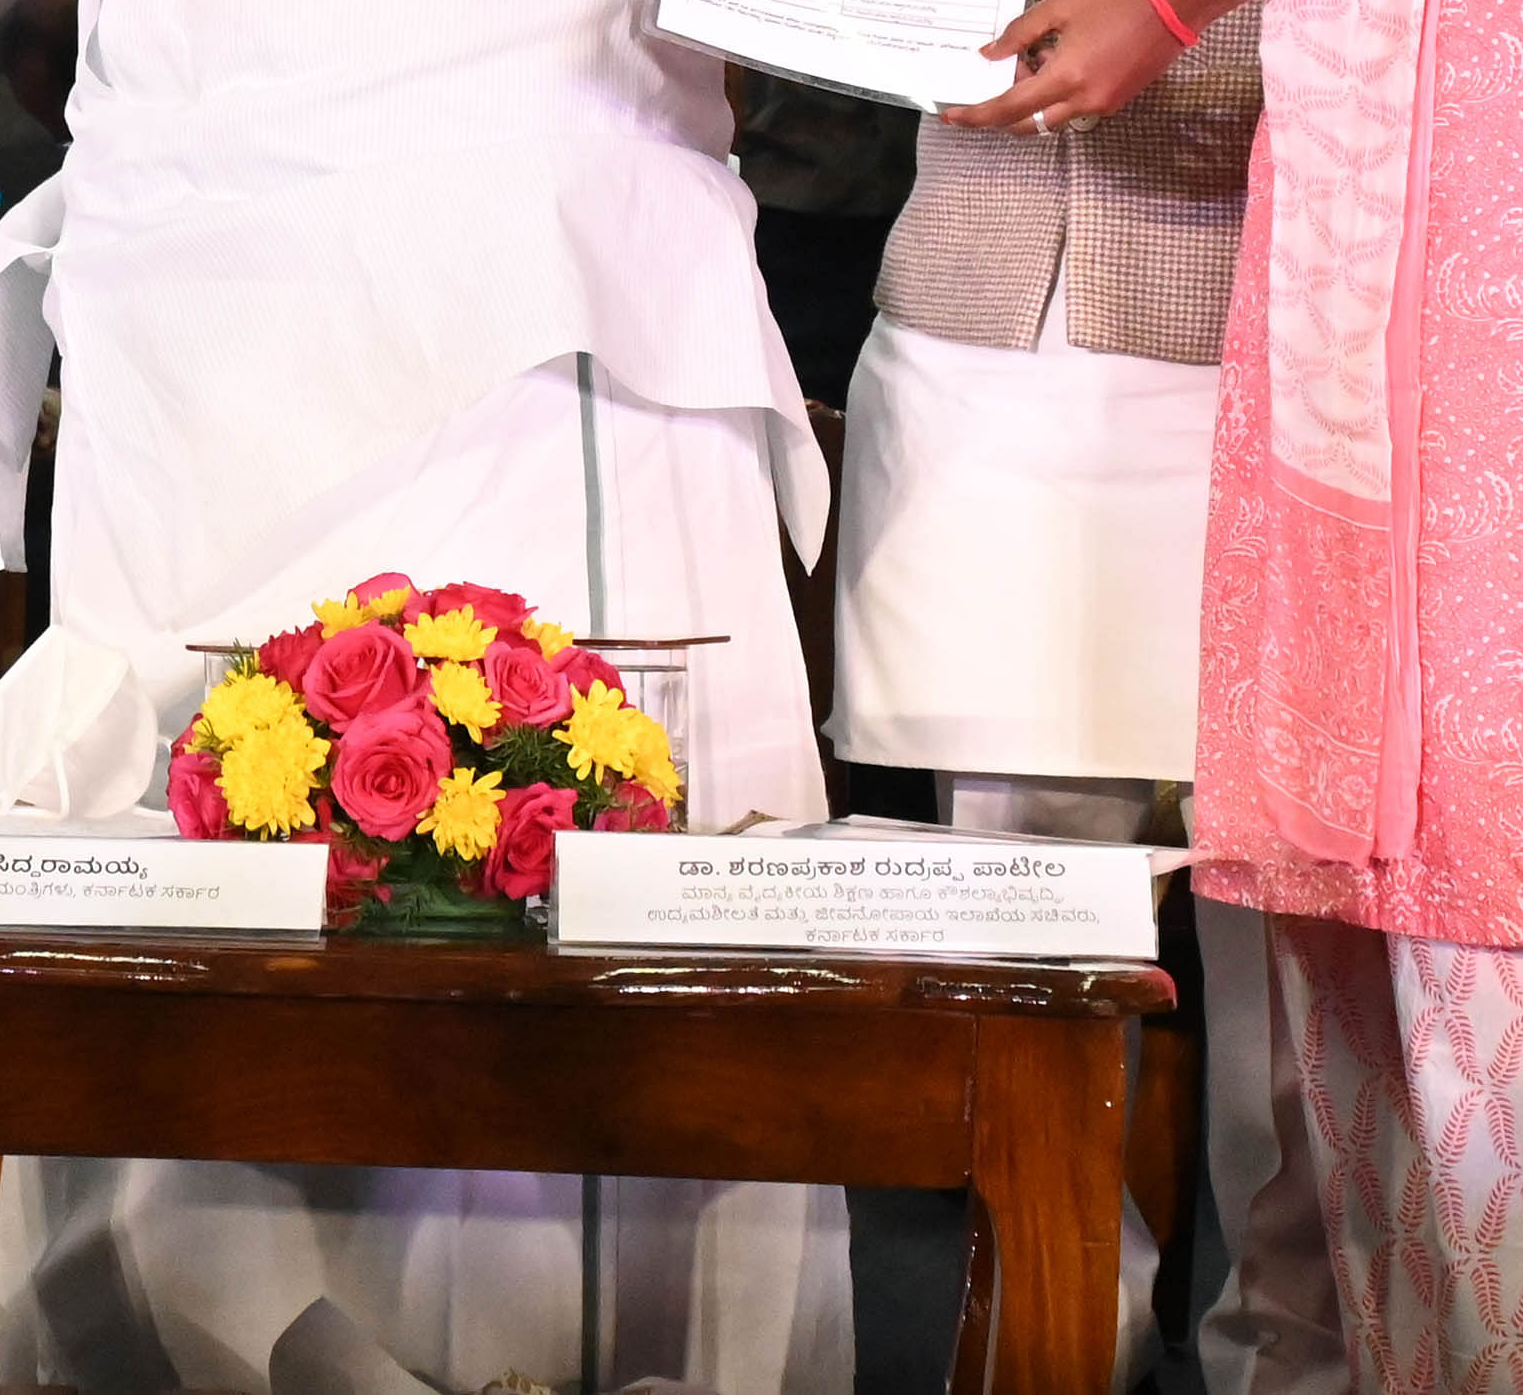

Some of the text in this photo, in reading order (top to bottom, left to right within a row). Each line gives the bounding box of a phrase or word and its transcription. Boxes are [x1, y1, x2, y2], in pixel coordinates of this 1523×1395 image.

[678, 855, 1066, 881] ಡಾ. ಶರಣಪ್ರಕಾಶ ರುದ್ರಪ್ಪ ಪಾಟೀಲ
[83, 883, 157, 899] ಕರ್ನಾಟಕ
[161, 885, 220, 900] ಸರ್ಕಾರ
[682, 885, 733, 902] ಮಾನ್ಯ
[738, 885, 828, 902] ವೈದ್ಯಕೀಯ
[833, 882, 874, 903] ಶಿಕ್ಷಣ
[879, 886, 932, 902] ಹಾಗೂ
[647, 904, 1101, 926] ಉದ್ಯಮಶೀಲತೆ ಮತ್ತು ಜೀವನೋಪಾಯ ಇಲಾಖೆಯ ಸಚಿವರು,
[805, 927, 945, 944] ಕರ್ನಾಟಕ ಸರ್ಕಾರ
